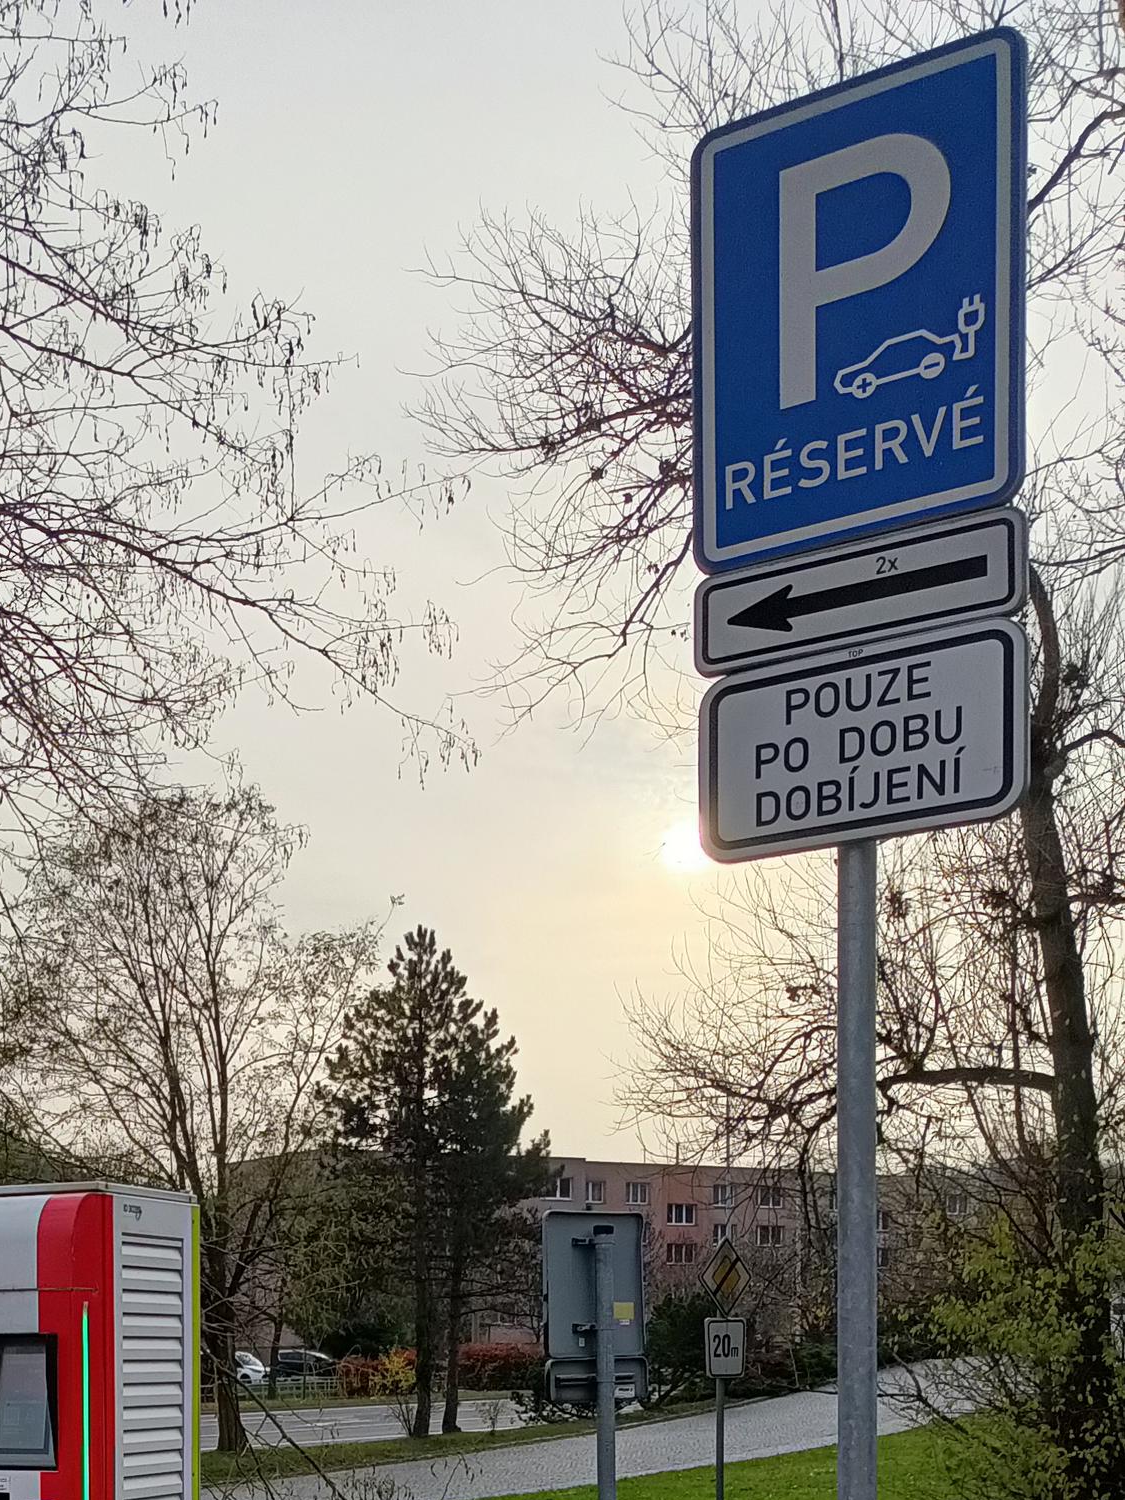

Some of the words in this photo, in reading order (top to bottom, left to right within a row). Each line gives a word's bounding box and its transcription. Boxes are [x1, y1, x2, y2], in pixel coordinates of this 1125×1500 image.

[779, 133, 951, 410] P
[725, 384, 984, 511] RÉSERVÉ
[876, 556, 899, 575] 2x
[785, 661, 932, 726] POUZE
[755, 736, 809, 779] PO
[839, 706, 962, 764] DOBU
[756, 746, 966, 827] DOBÍJENÍ
